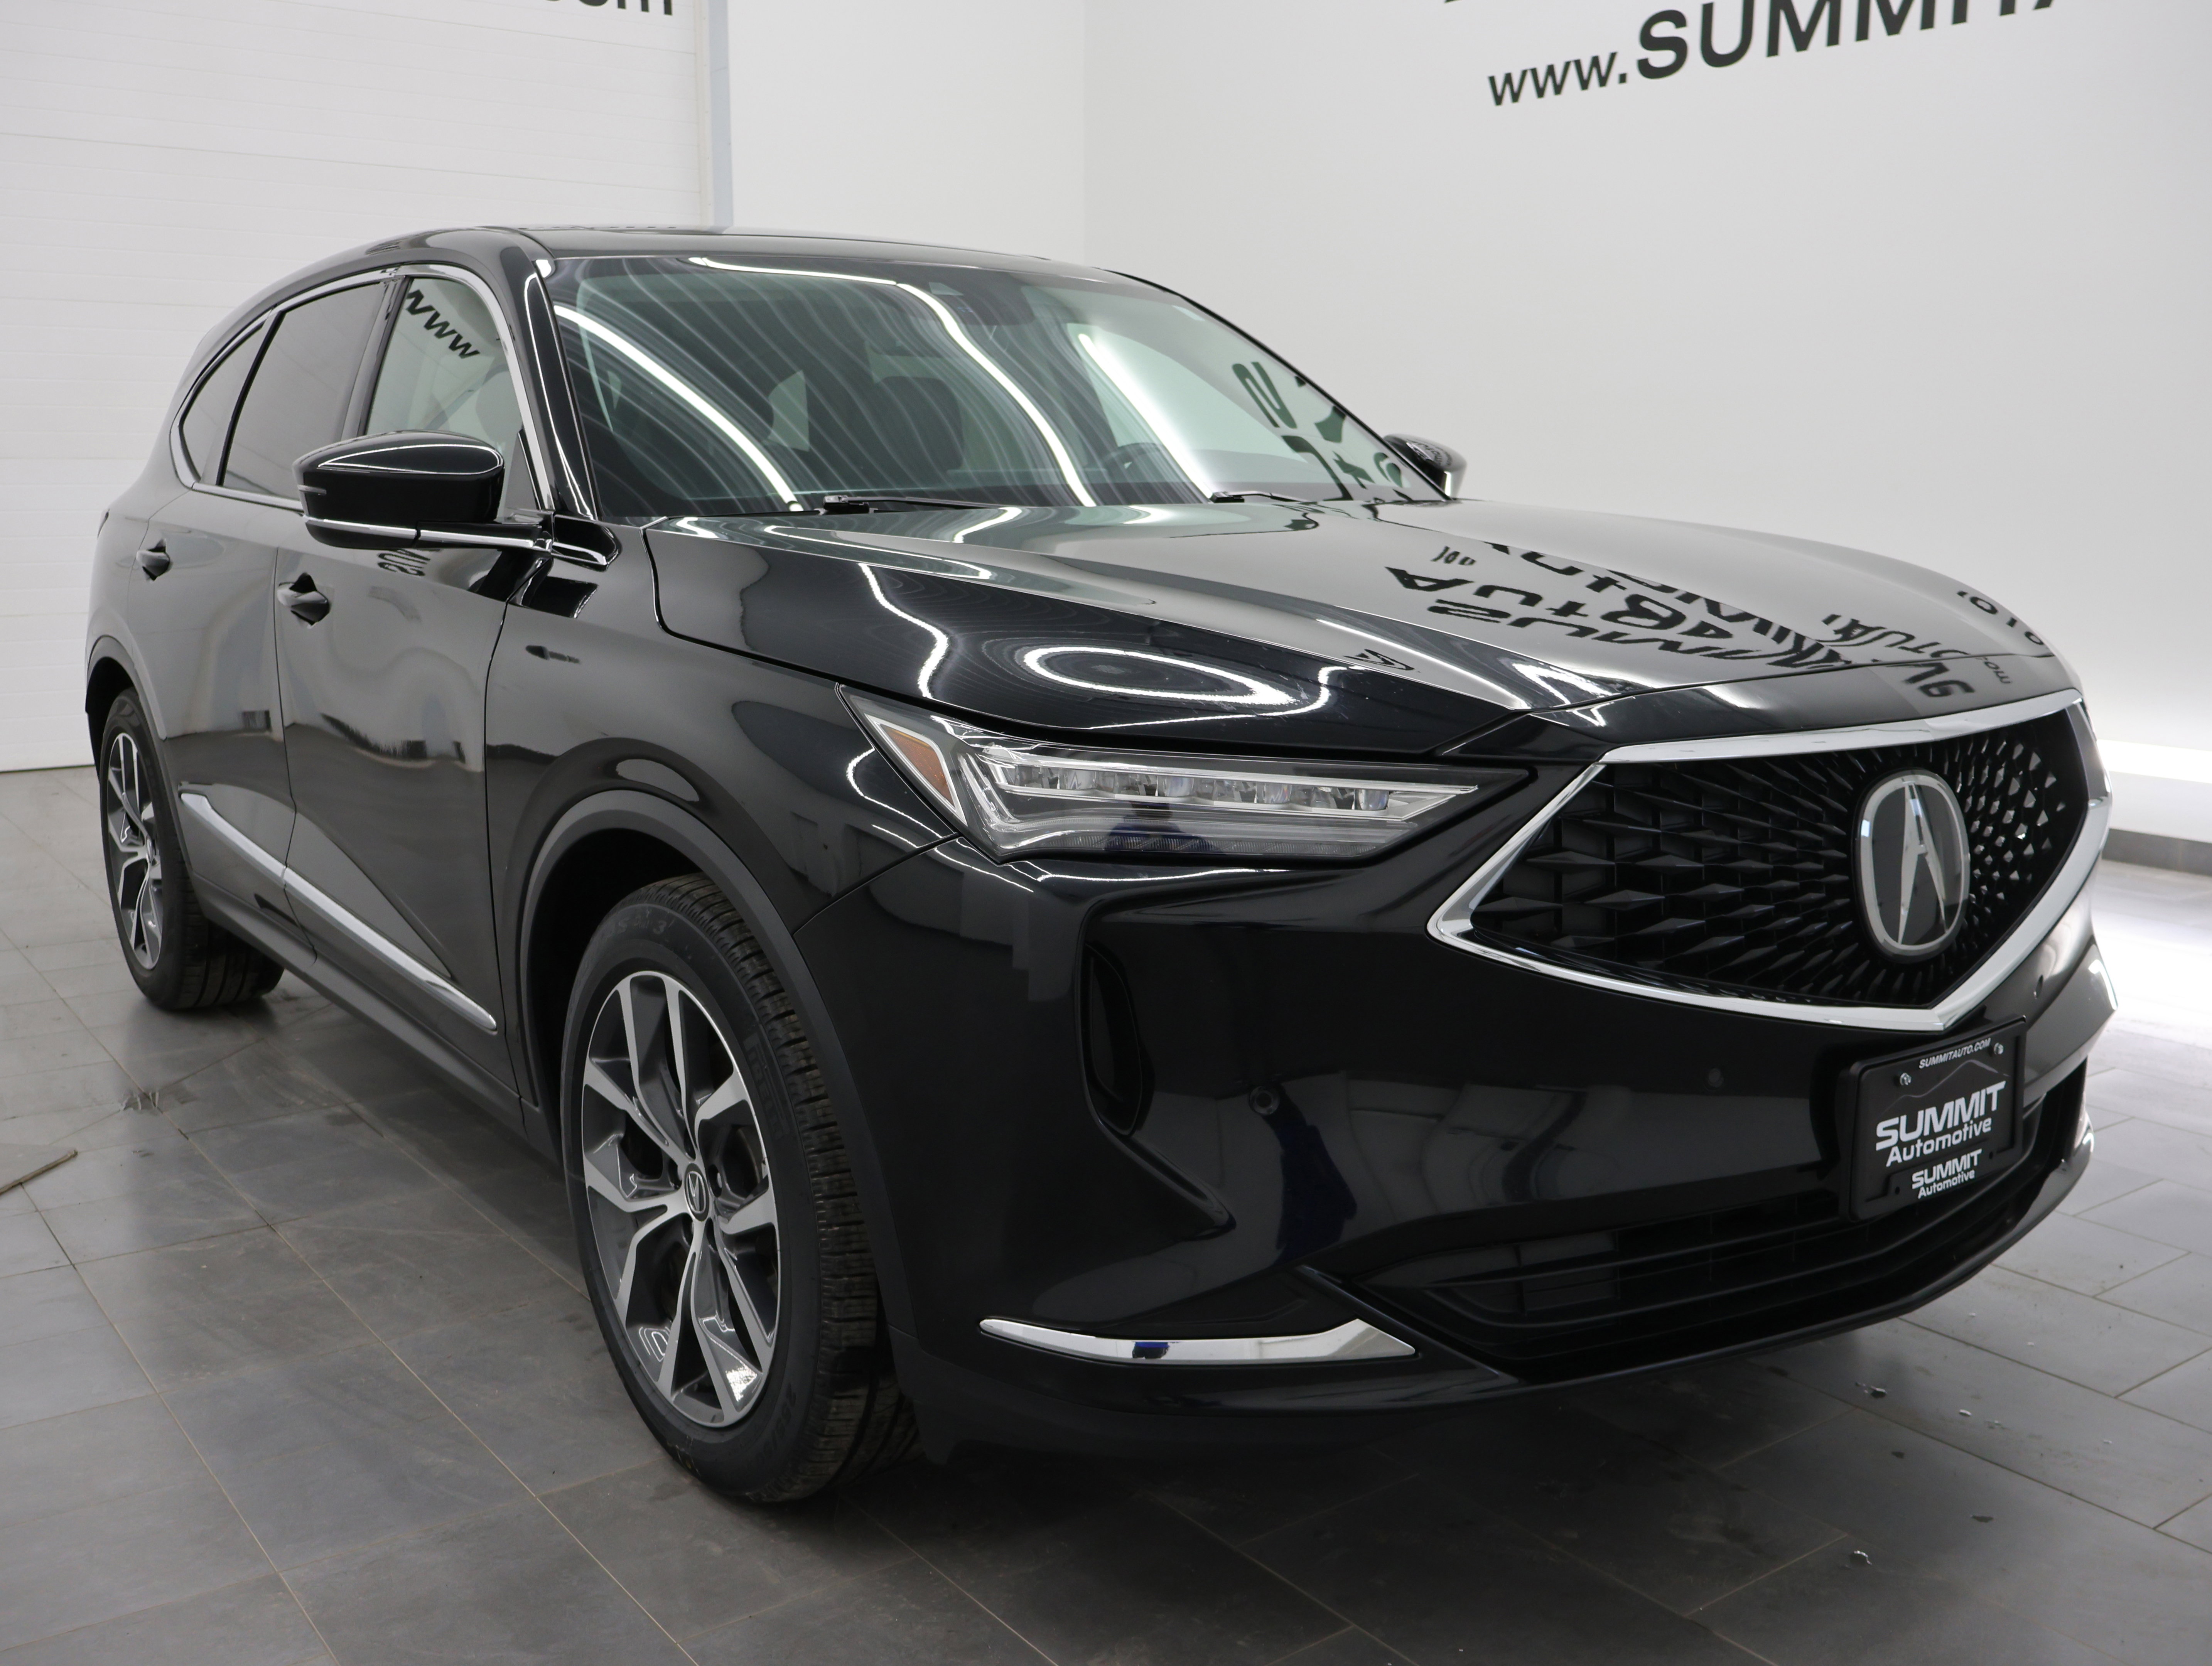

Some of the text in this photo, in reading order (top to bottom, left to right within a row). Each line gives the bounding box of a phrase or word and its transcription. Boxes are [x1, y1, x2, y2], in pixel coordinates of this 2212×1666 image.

[1919, 1038, 1991, 1069] SUMMITAUTO.COM
[1876, 1081, 2006, 1151] SUMMIT
[1886, 1118, 1992, 1167] Automotive
[1912, 1149, 1983, 1189] SUMMIT
[1918, 1169, 1975, 1199] Automotive
